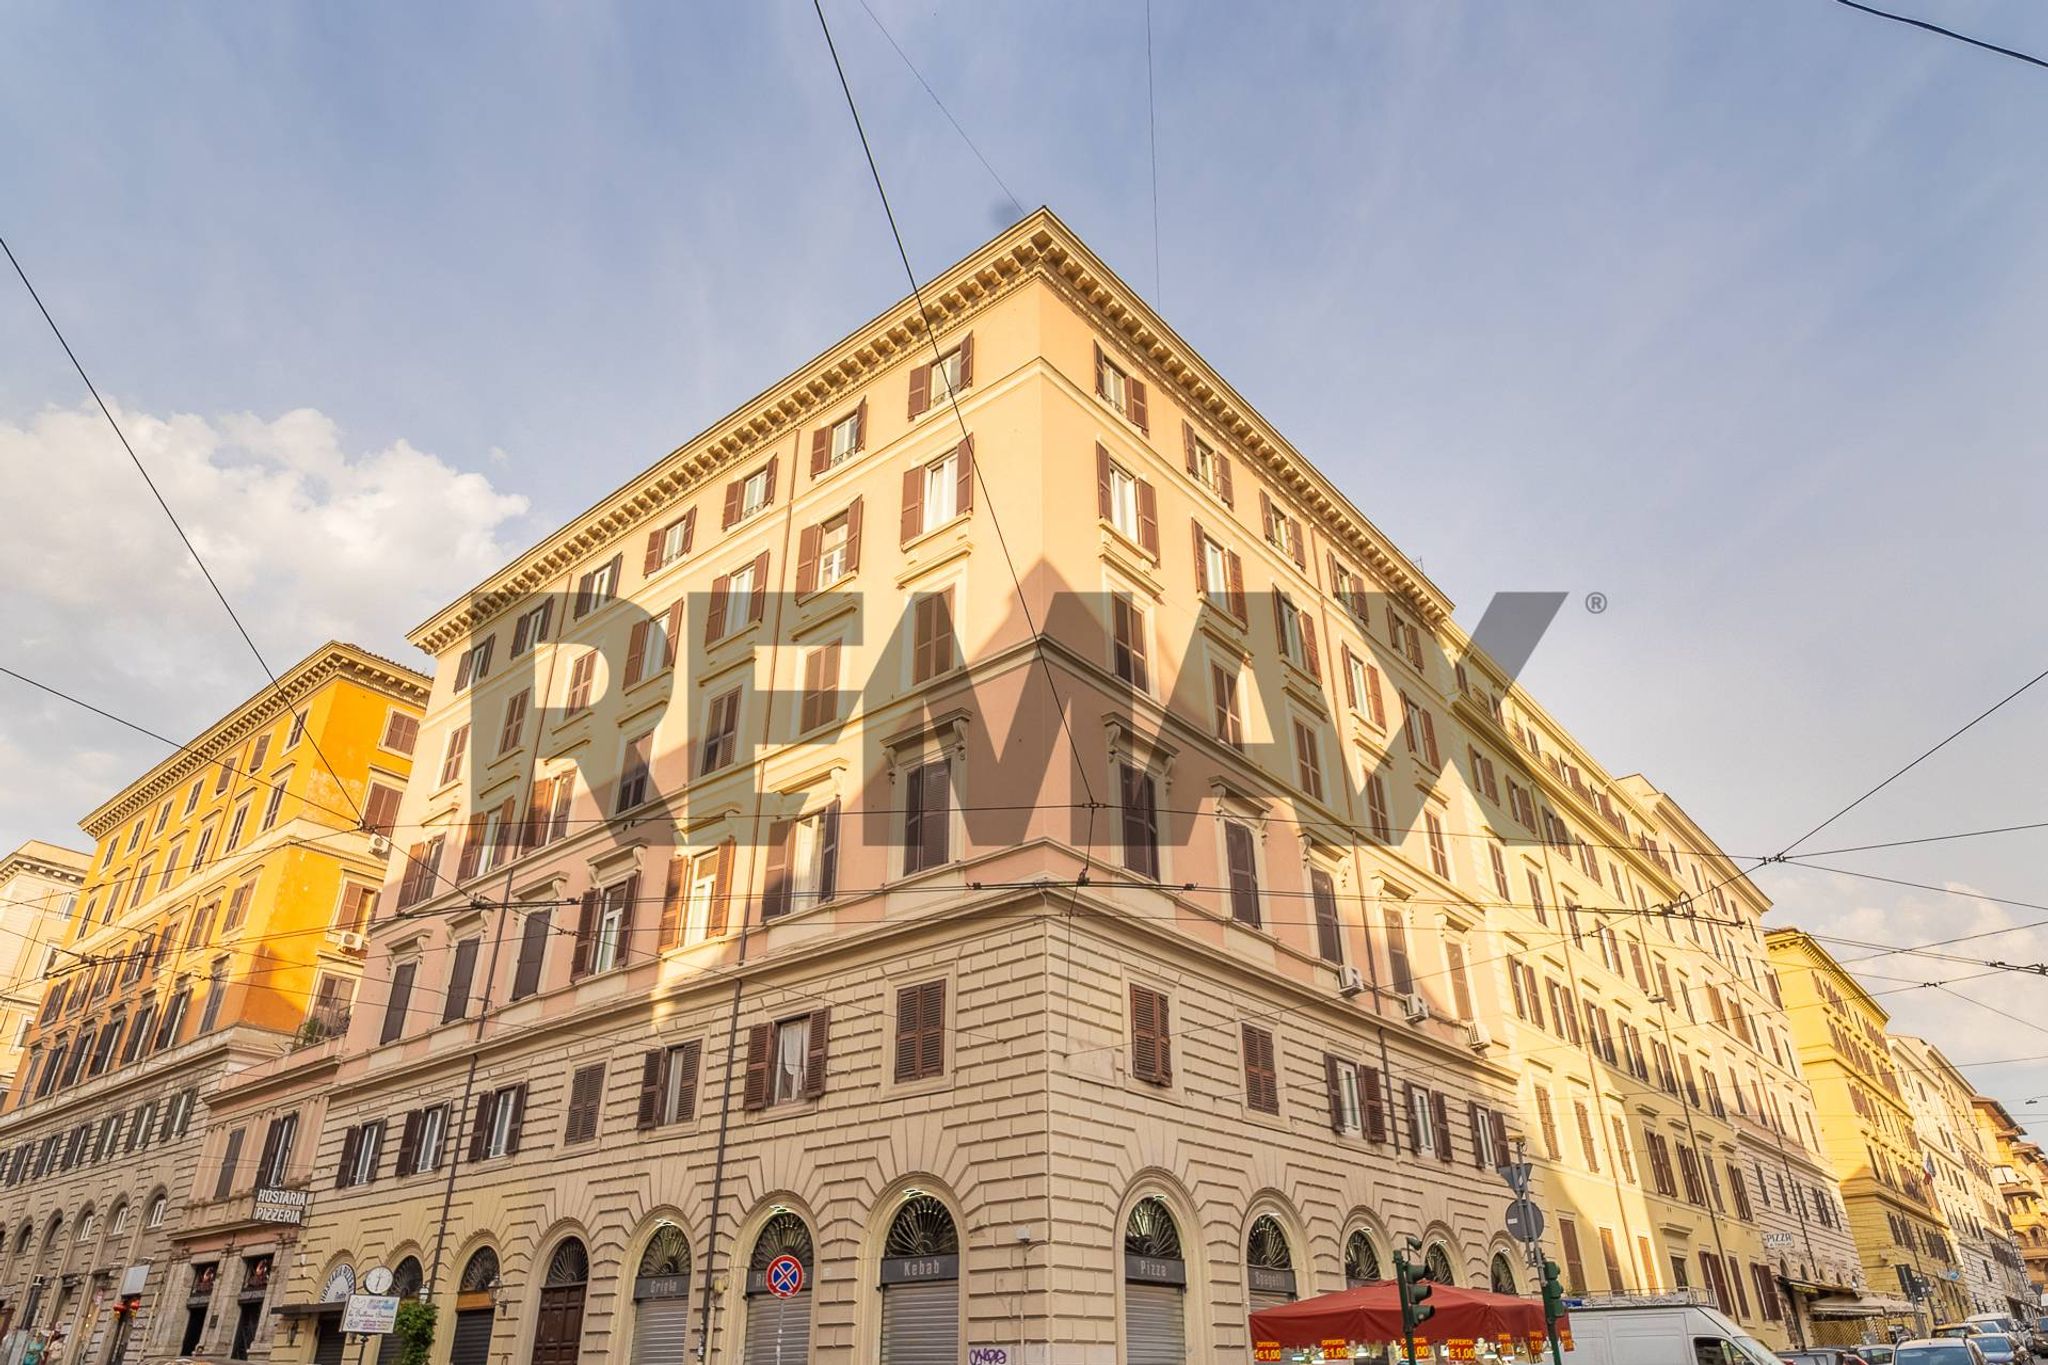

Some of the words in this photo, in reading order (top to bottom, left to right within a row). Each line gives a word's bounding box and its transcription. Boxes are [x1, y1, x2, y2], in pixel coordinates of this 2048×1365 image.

[258, 1189, 306, 1206] HOSTARIA
[255, 1207, 300, 1224] PIZZERIA
[1766, 1232, 1792, 1242] PIZZA
[904, 1259, 940, 1276] Kebab
